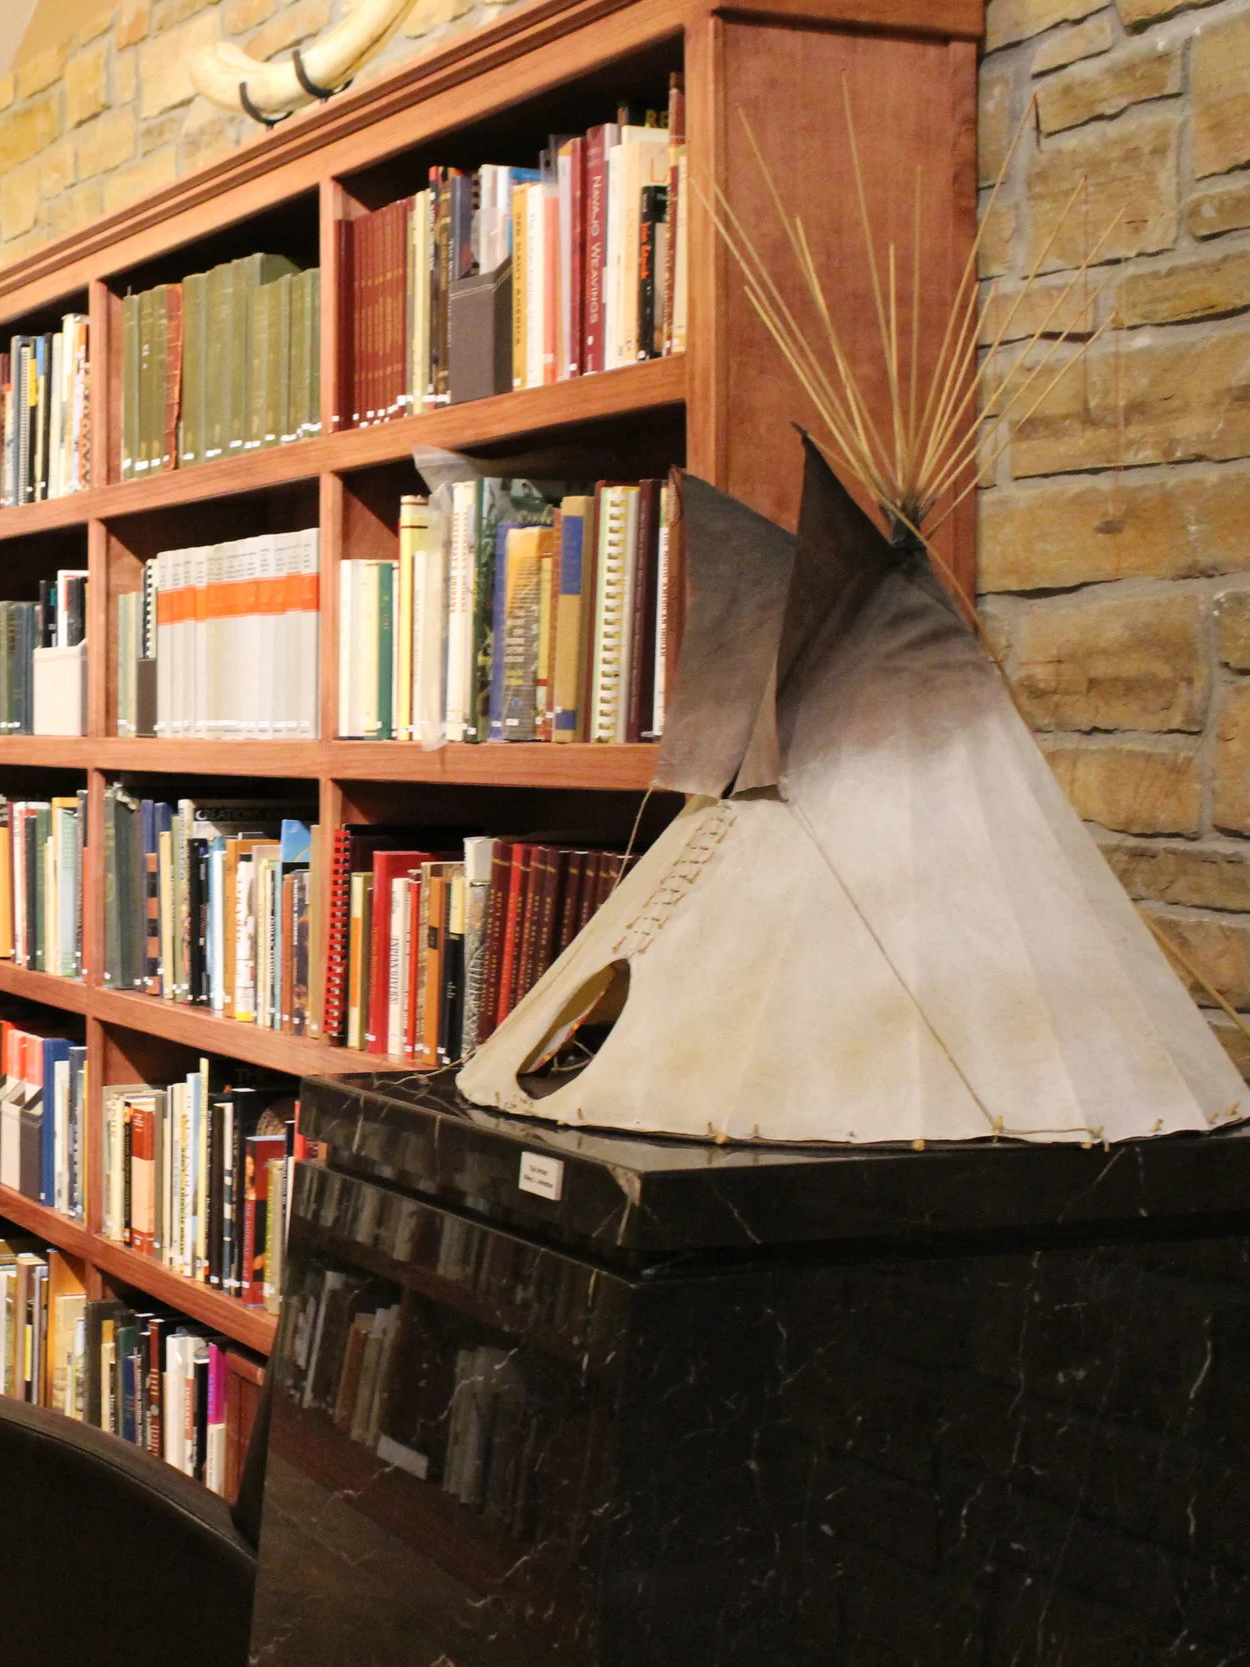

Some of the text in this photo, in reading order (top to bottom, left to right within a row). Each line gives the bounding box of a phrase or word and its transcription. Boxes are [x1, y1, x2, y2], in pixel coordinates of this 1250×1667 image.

[589, 175, 603, 324] NAVAJO WEAVINGS
[391, 938, 400, 969] INDIAN
